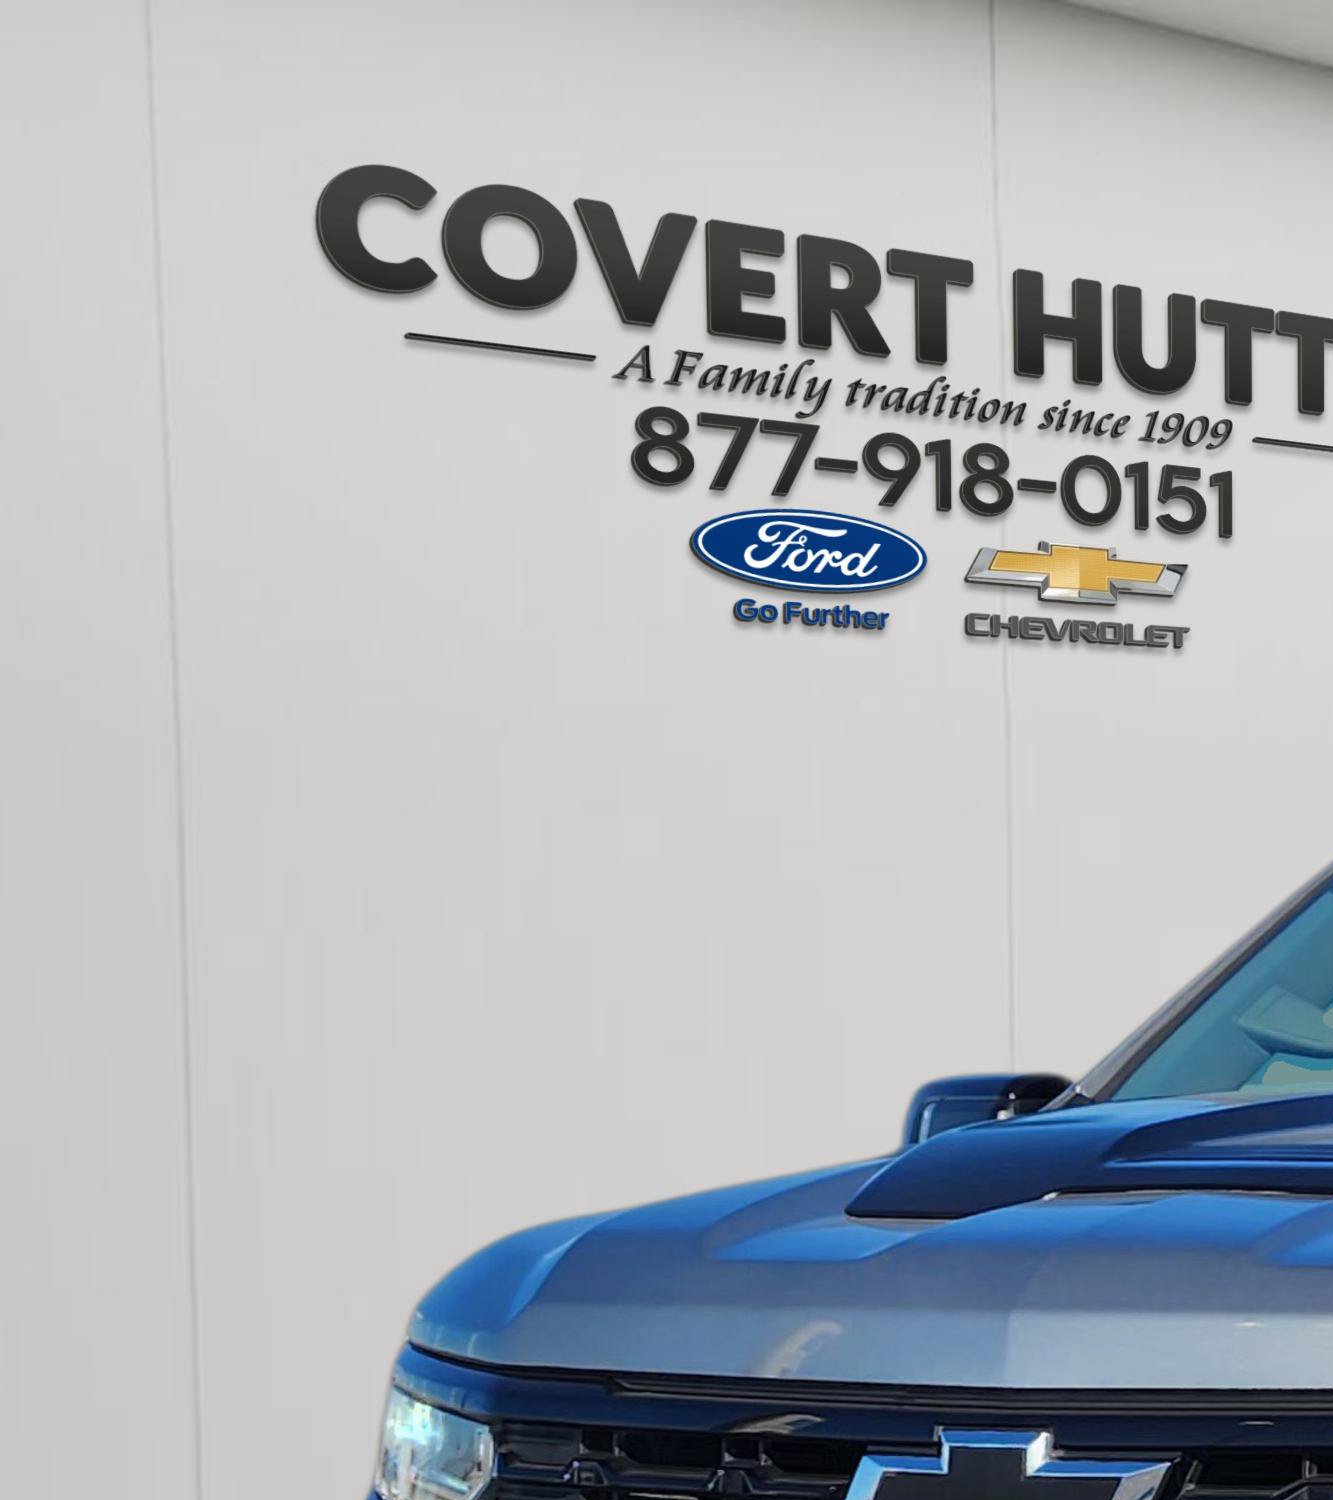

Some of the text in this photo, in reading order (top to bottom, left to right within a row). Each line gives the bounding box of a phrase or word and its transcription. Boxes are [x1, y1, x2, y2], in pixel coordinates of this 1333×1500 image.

[316, 165, 974, 367] COVERT
[612, 345, 1234, 450] A Family tradition since 1909
[631, 407, 1233, 540] 877-918-0151
[742, 520, 880, 581] Ford
[732, 598, 890, 631] Go Further
[964, 613, 1190, 650] CHEVROLET
